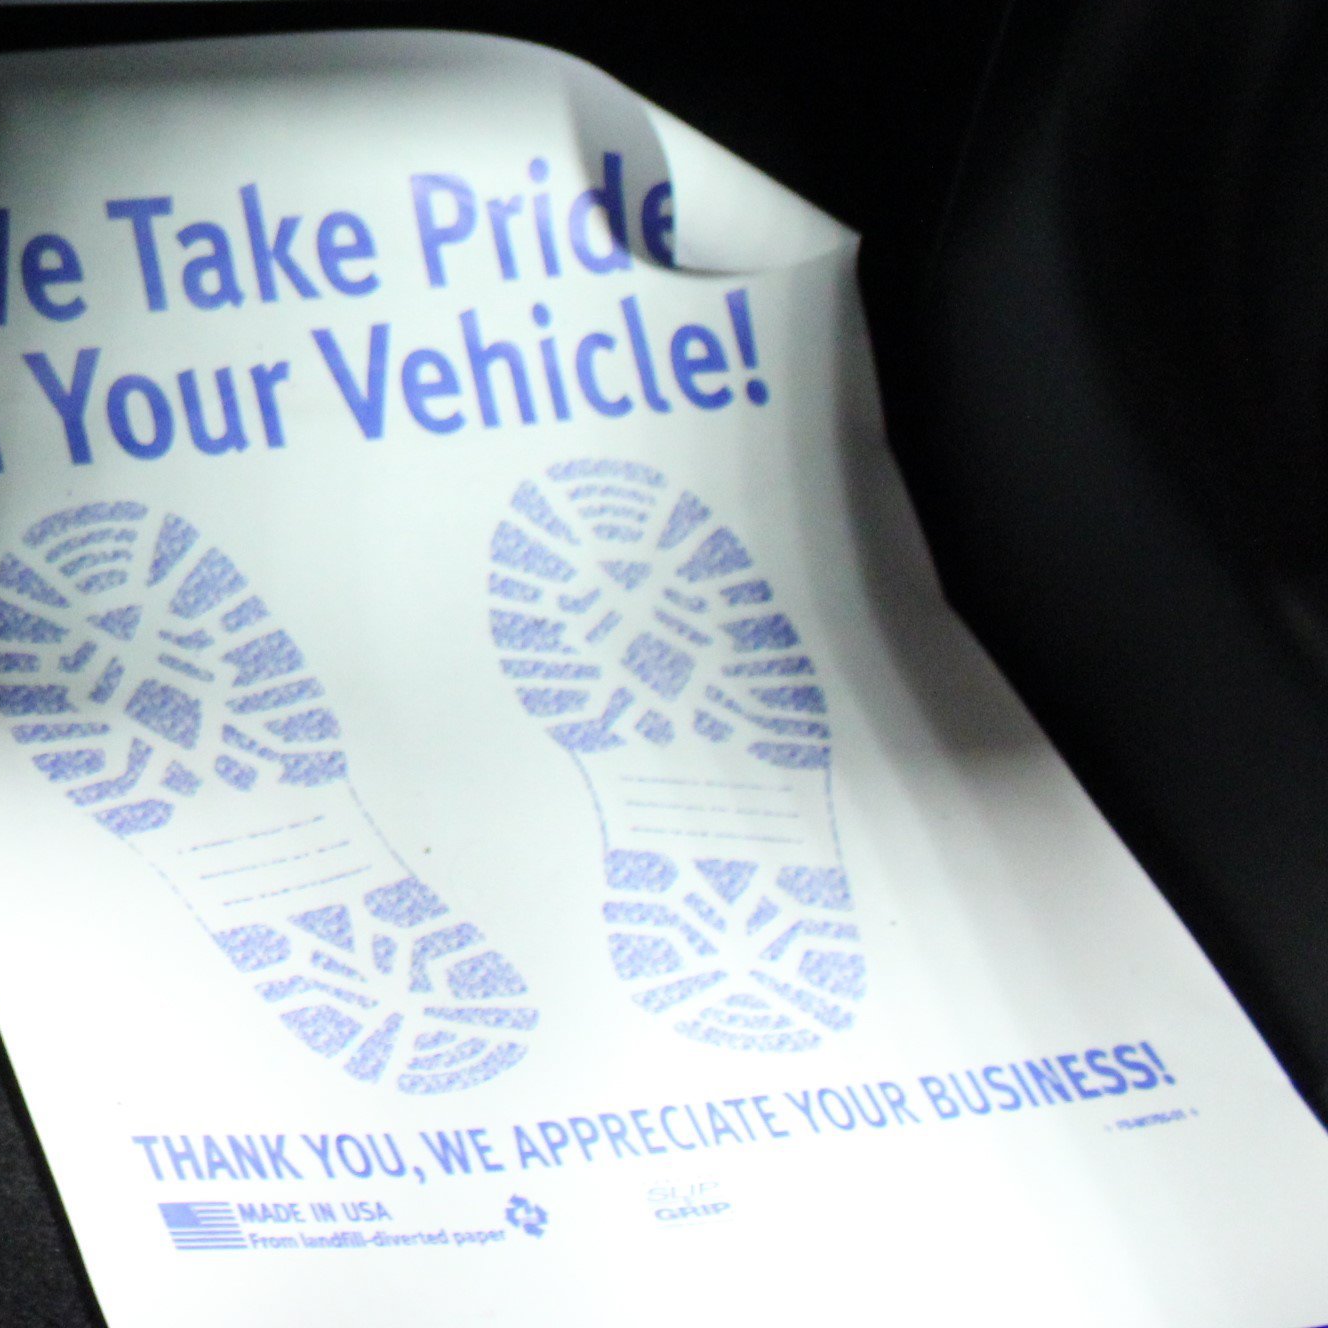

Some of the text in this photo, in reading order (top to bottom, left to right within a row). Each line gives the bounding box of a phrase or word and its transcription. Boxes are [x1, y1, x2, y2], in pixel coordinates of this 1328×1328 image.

[104, 182, 380, 314] Take
[22, 346, 292, 466] Your
[311, 288, 770, 442] Vehicle!
[131, 1134, 304, 1181] THANK
[300, 1132, 428, 1185] YOU,
[419, 1127, 506, 1176] WE
[513, 1094, 791, 1170] APPRECIATE
[784, 1081, 922, 1134] YOUR
[917, 1040, 1178, 1121] BUSINESS!
[236, 1201, 393, 1224] MADE IN USA
[248, 1233, 297, 1250] From
[452, 1228, 506, 1249] paper
